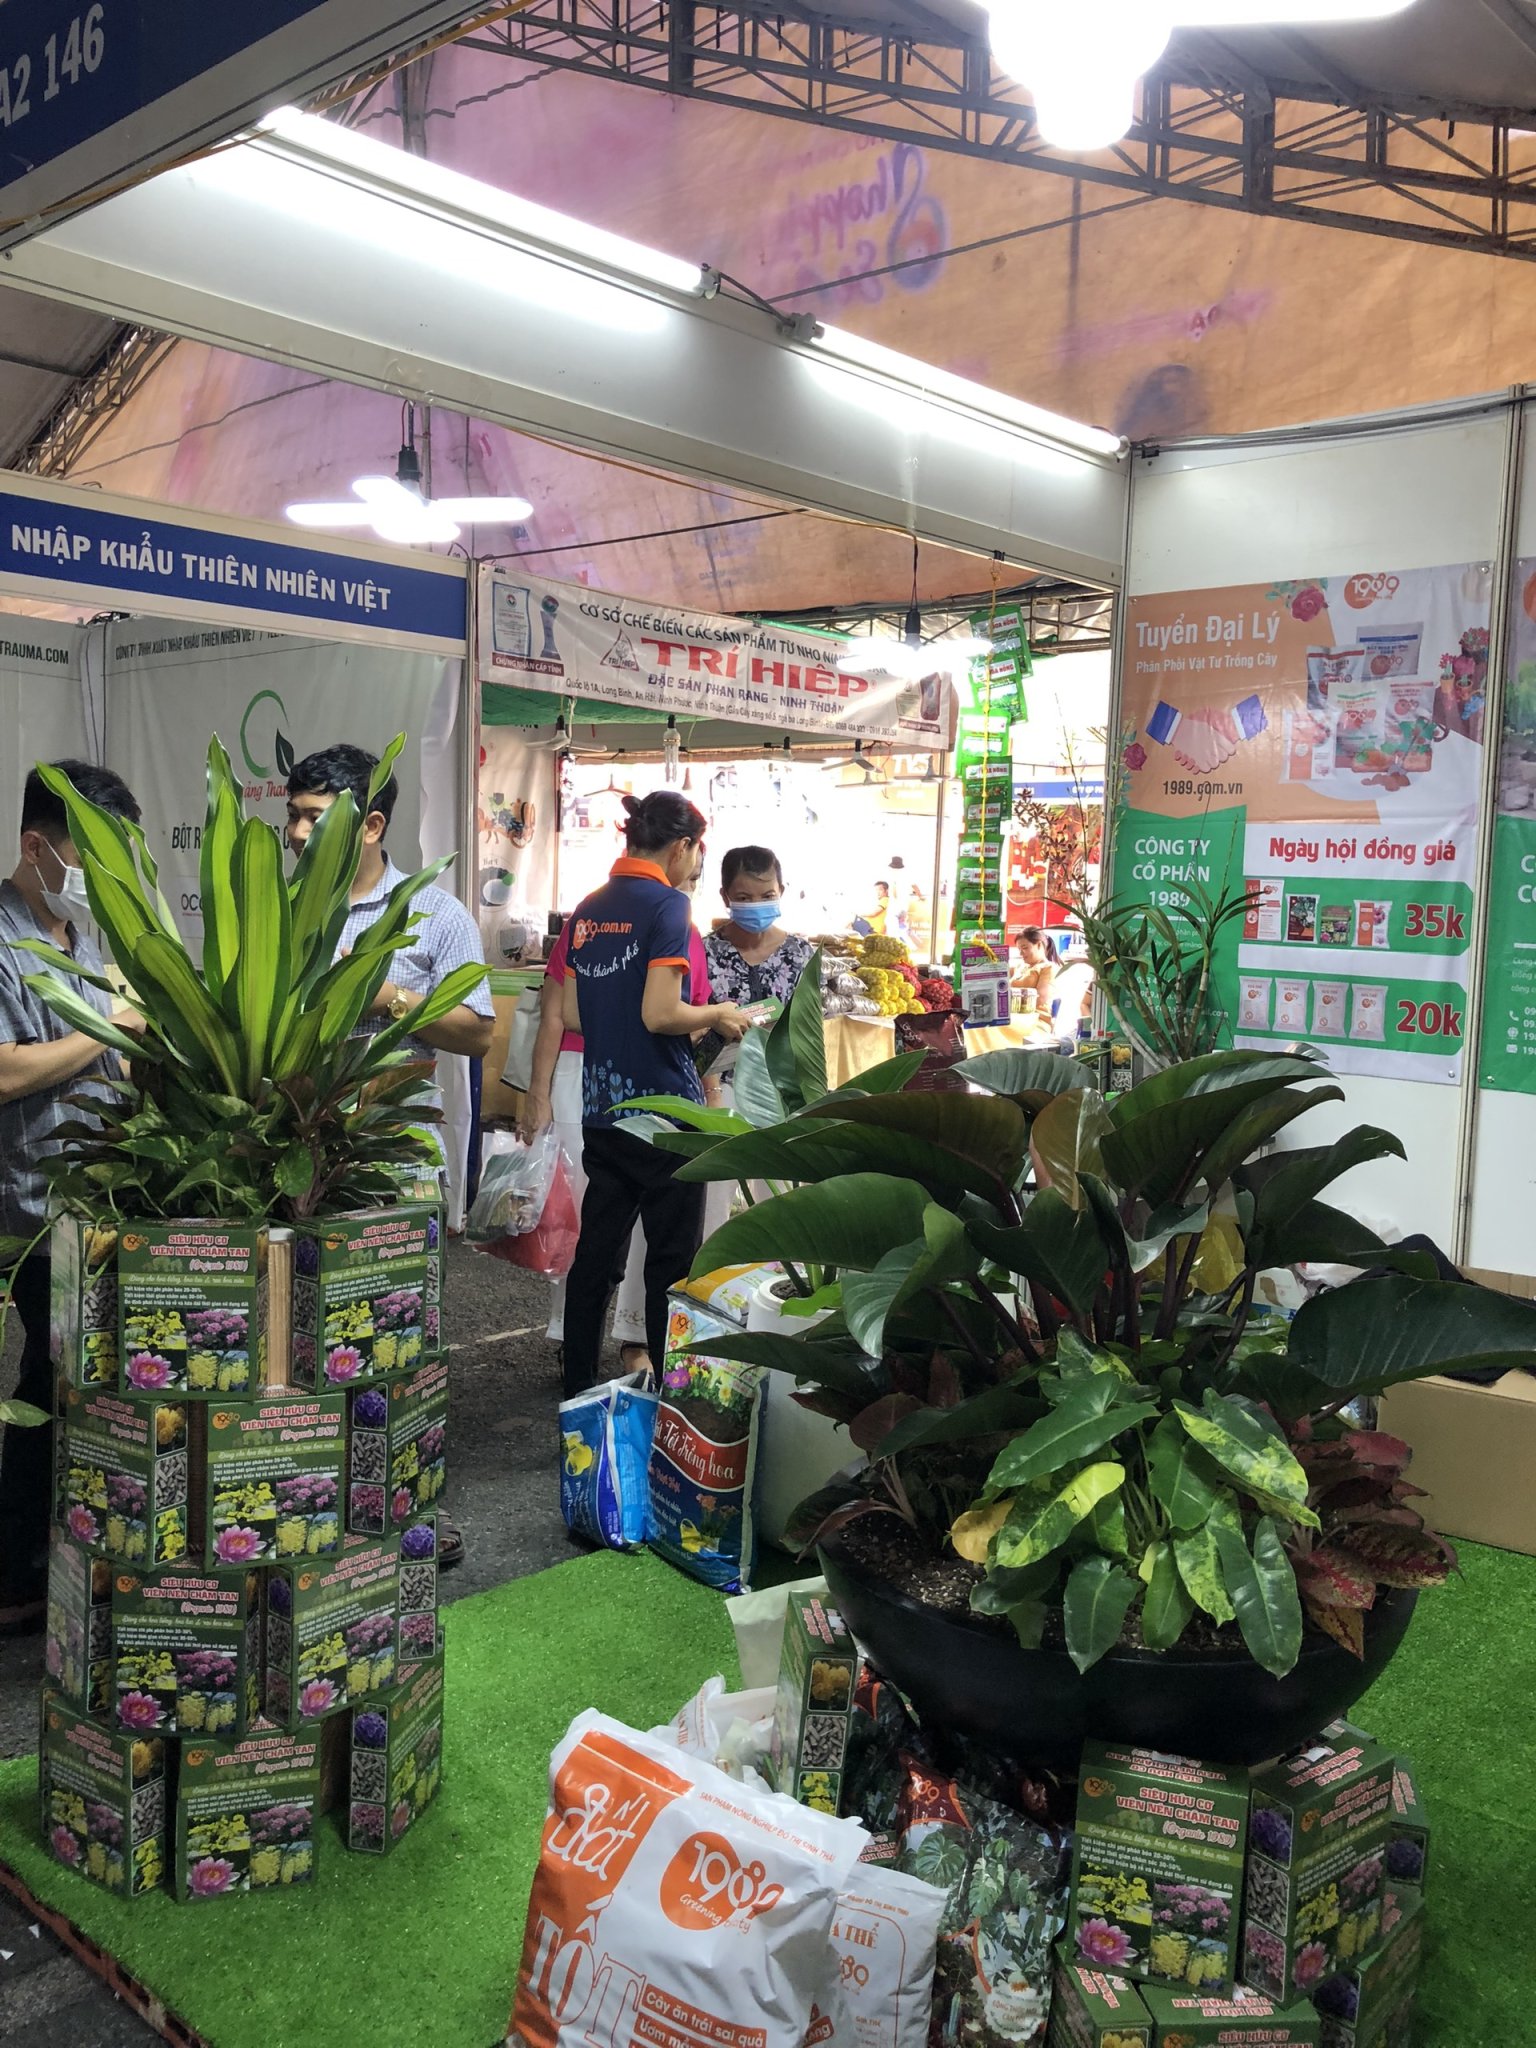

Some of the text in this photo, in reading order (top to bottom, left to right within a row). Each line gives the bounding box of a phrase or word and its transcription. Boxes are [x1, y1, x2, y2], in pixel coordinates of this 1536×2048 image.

[44, 3, 104, 102] 146
[11, 524, 391, 613] NHẬP KHẨU THIÊN NHIÊN VIỆT
[579, 603, 600, 618] CƠ
[602, 606, 622, 624] SỞ
[624, 613, 652, 630] CHẾ
[653, 615, 683, 637] BIẾN
[687, 623, 713, 640] CÁC
[716, 627, 741, 645] SẢN
[743, 632, 777, 652] PHẨM
[779, 640, 796, 655] TỪ
[797, 645, 821, 661] NHO
[1136, 610, 1280, 651] Tuyển Đại Lý
[641, 637, 869, 698] TRÍ HIỆP
[1163, 658, 1186, 672] Phối
[1189, 656, 1205, 672] Vật
[1209, 656, 1222, 668] Tư
[1225, 654, 1253, 670] Trồng
[1257, 652, 1278, 668] Cây
[648, 674, 673, 689] ĐẶC
[678, 676, 701, 692] SẢN
[706, 679, 736, 699] PHAN
[738, 688, 769, 704] RANG
[780, 695, 807, 710] NINH
[266, 780, 288, 797] Than
[172, 822, 193, 853] BỘT
[1134, 834, 1211, 857] CÔNG TY
[1269, 836, 1456, 866] Ngày hội đồng giá
[1132, 859, 1210, 883] CỔ PHẦN
[1149, 890, 1191, 908] 1989
[1404, 904, 1465, 939] 35k
[593, 956, 619, 978] thành
[621, 939, 640, 970] phố
[1396, 1000, 1462, 1037] 20k
[663, 1420, 680, 1451] Tốt
[709, 1451, 736, 1480] hoa
[1116, 1795, 1239, 1831] VIÊN NÉN CHẬM TAN
[1139, 1786, 1214, 1811] SIÊU HỮU CƠ
[732, 1806, 751, 1822] NÔNG
[801, 1840, 819, 1854] SINH
[679, 1893, 722, 1924] Greening
[639, 2018, 666, 2041] Ươm
[646, 1990, 764, 2048] Cây ăn trái sai quả
